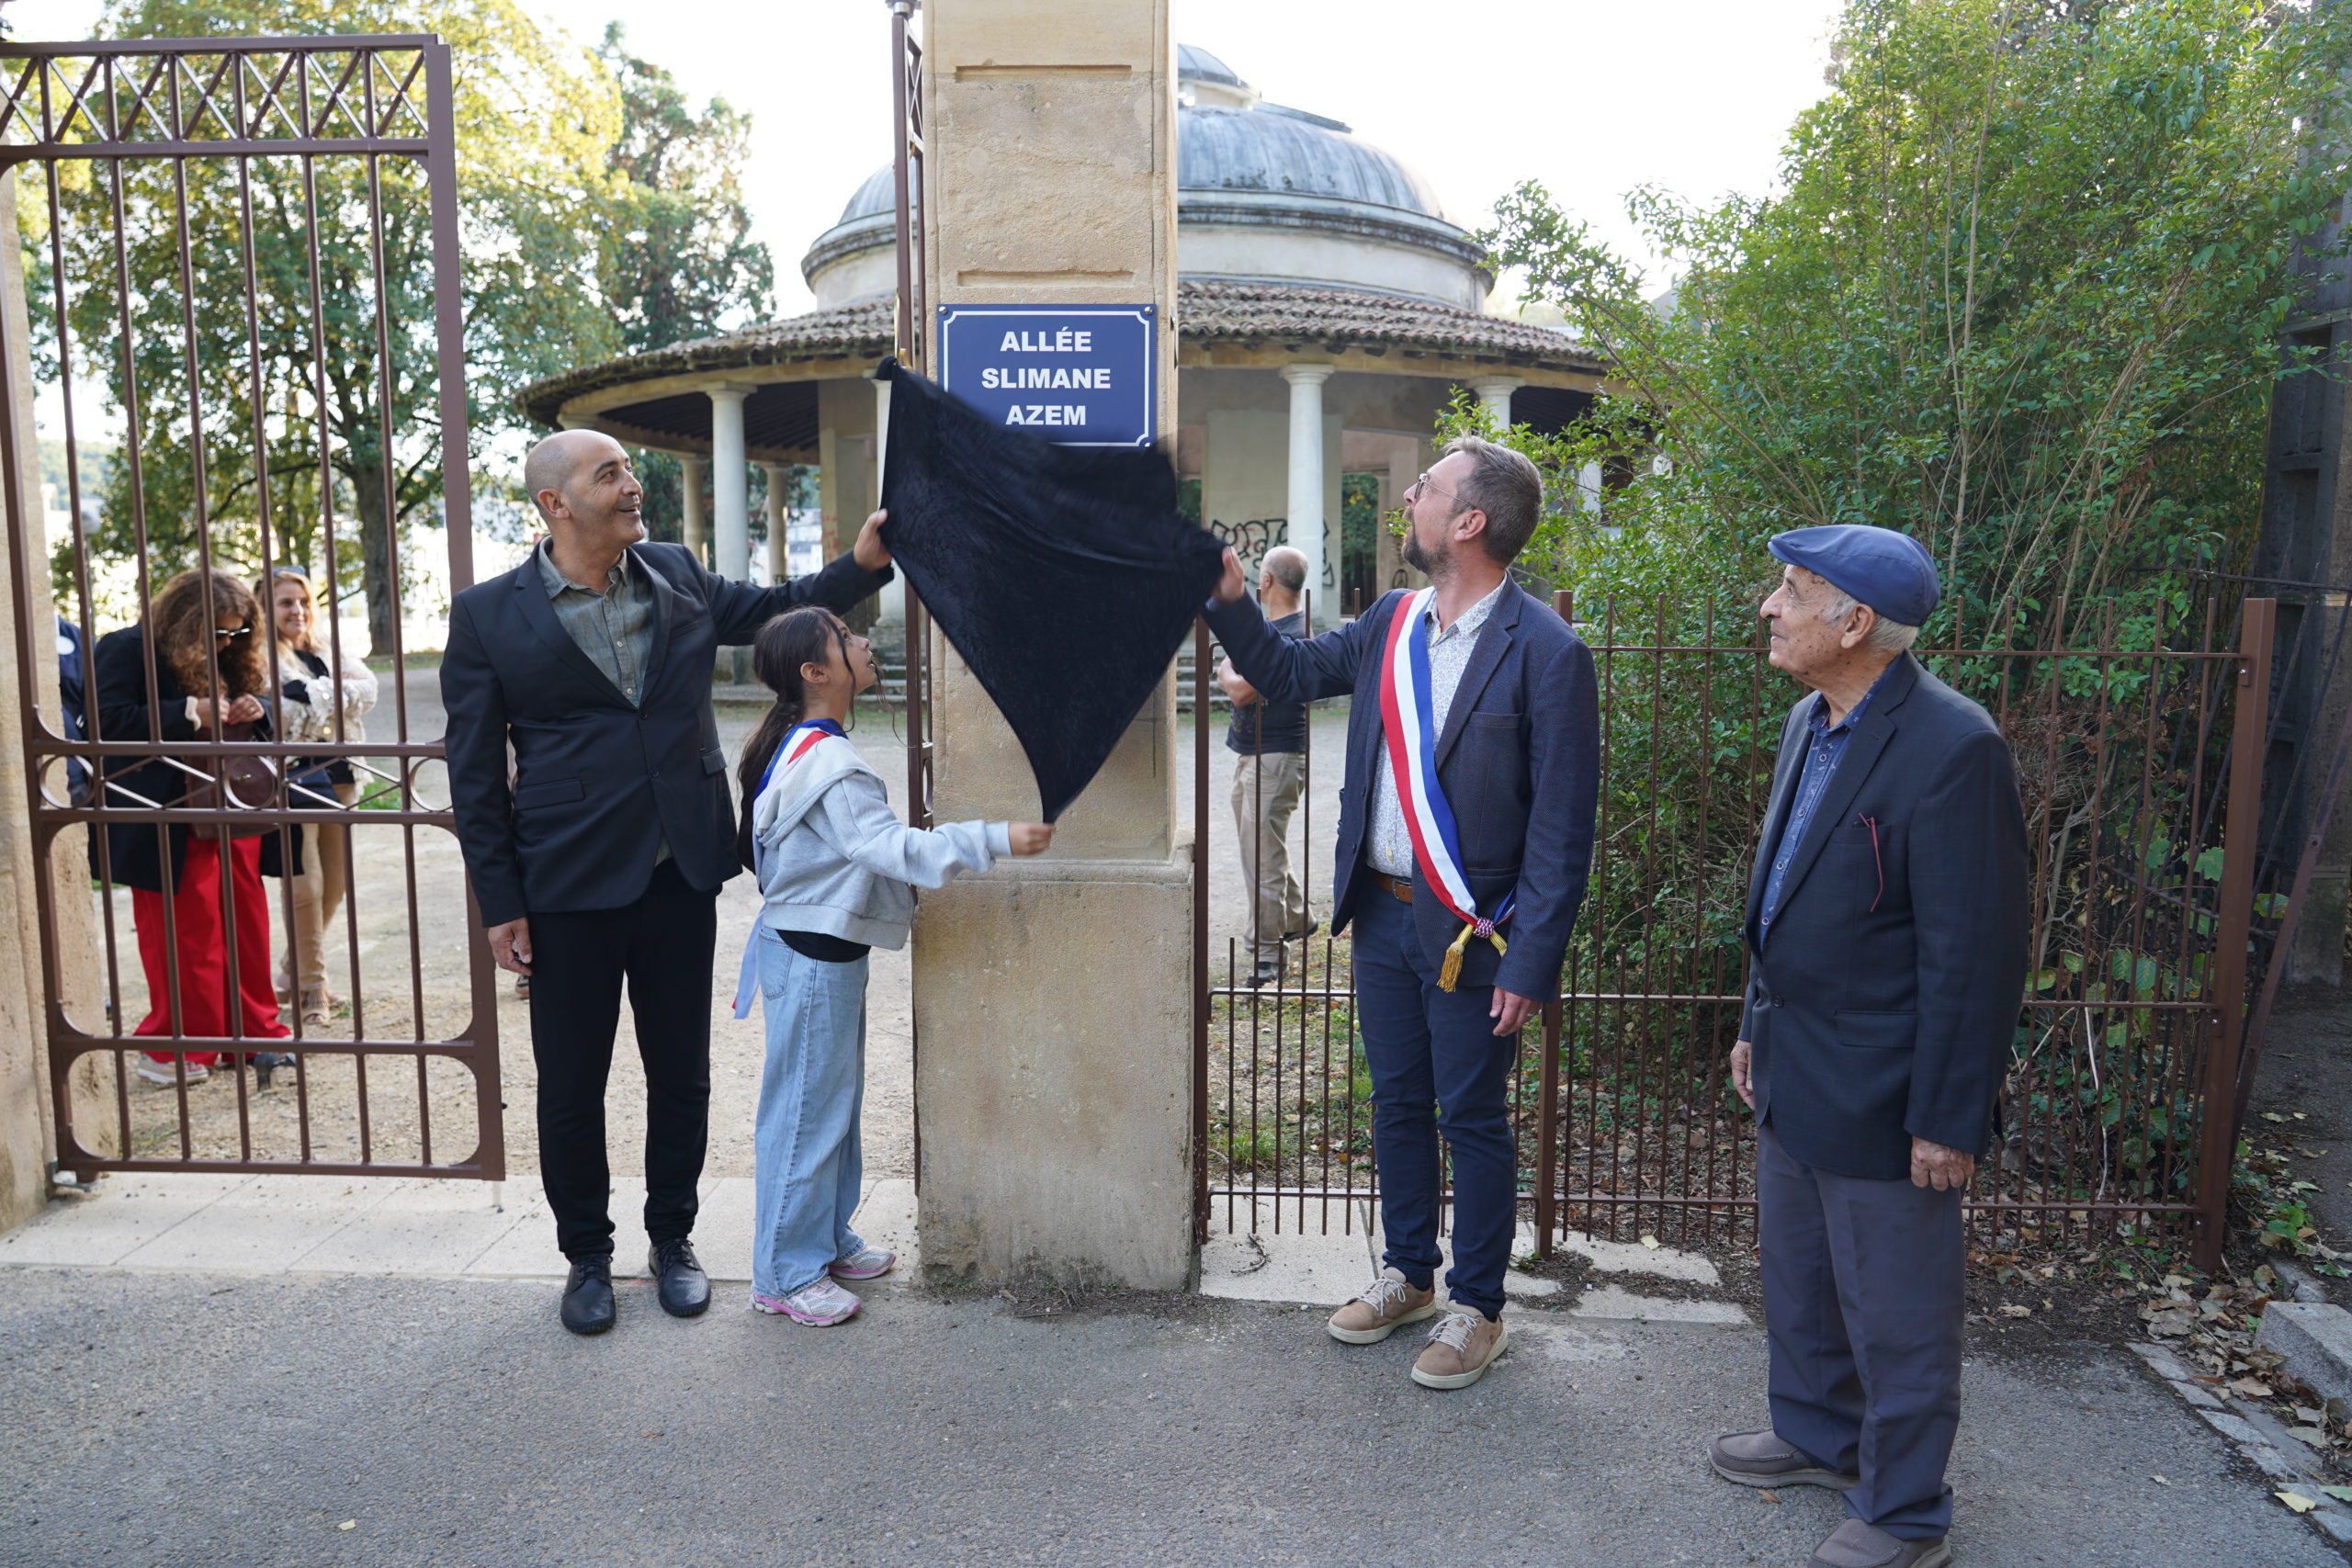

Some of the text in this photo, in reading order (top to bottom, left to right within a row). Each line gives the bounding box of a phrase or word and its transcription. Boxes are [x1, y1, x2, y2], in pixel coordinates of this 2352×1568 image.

[1000, 326, 1091, 352] ALLÉE
[981, 368, 1111, 389] SLIMANE
[1005, 405, 1086, 425] AZEM
